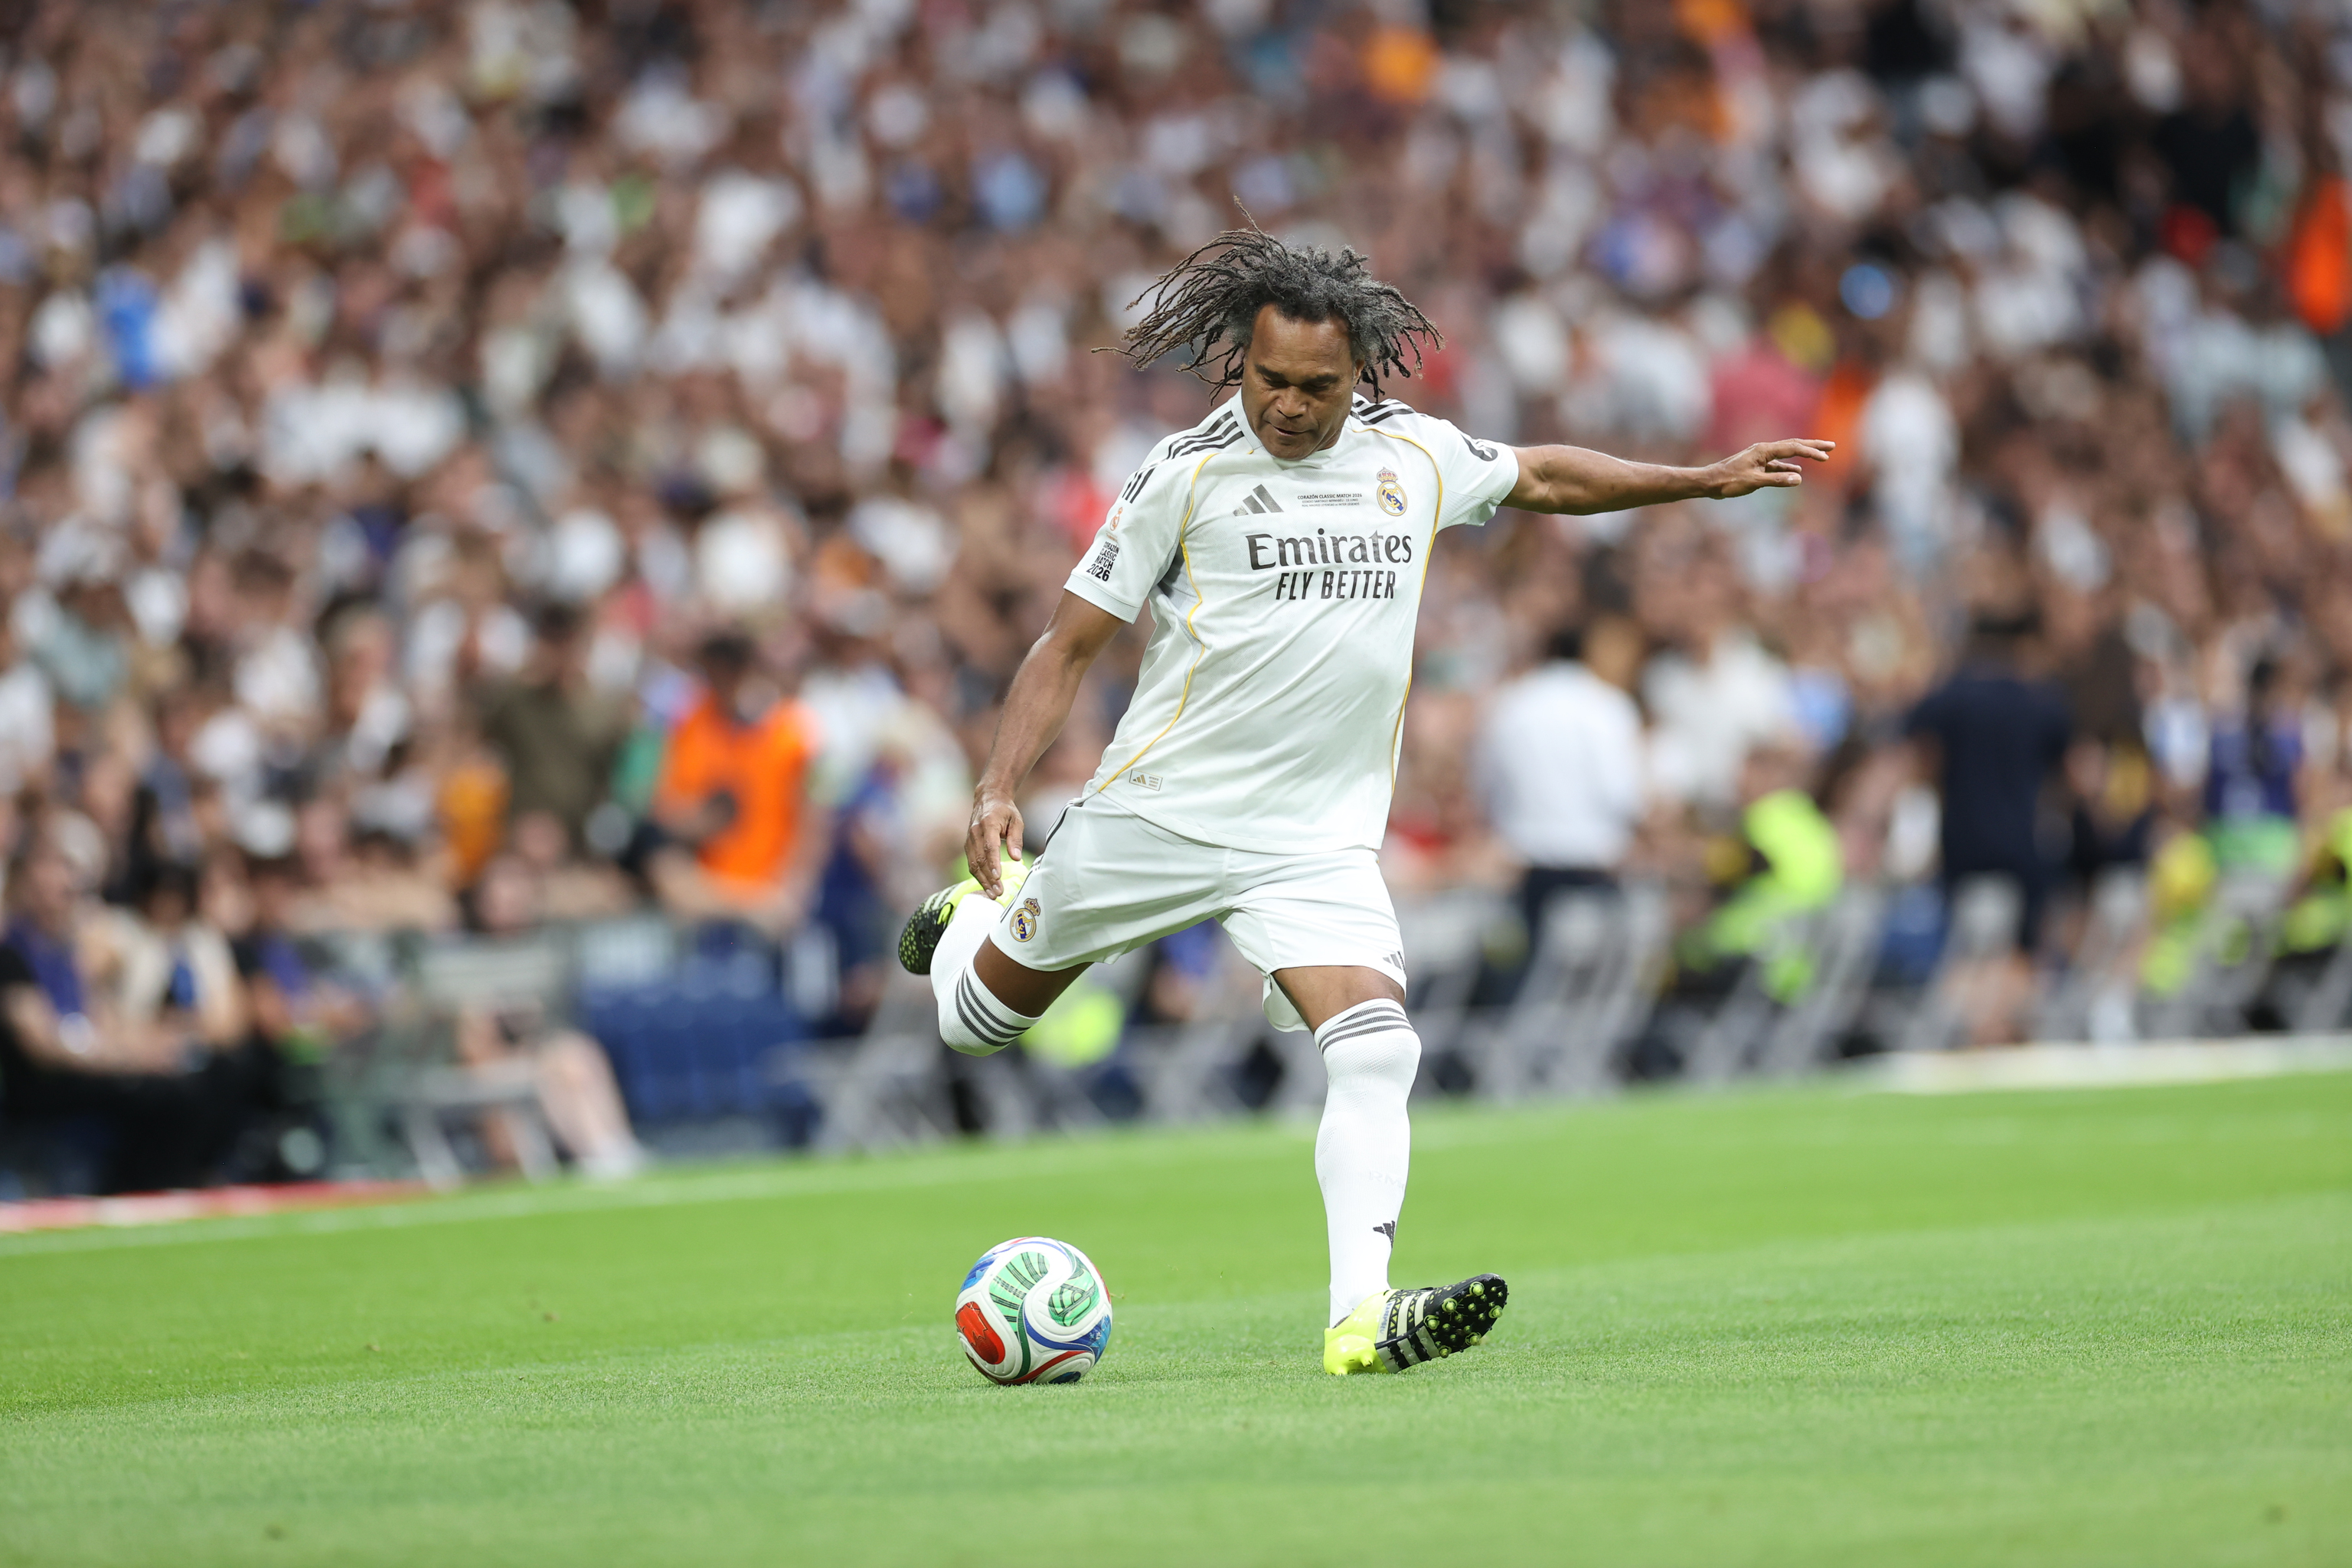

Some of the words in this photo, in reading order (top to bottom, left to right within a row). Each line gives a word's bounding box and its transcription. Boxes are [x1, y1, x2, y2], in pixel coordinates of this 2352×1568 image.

[1099, 548, 1117, 561] CLASSIC
[1103, 541, 1120, 554] CORAZÓN
[1246, 528, 1412, 570] Emirates
[1094, 555, 1114, 570] MATCH
[1086, 564, 1111, 582] 2026
[1276, 572, 1315, 600] FLY
[1320, 570, 1396, 599] BETTER
